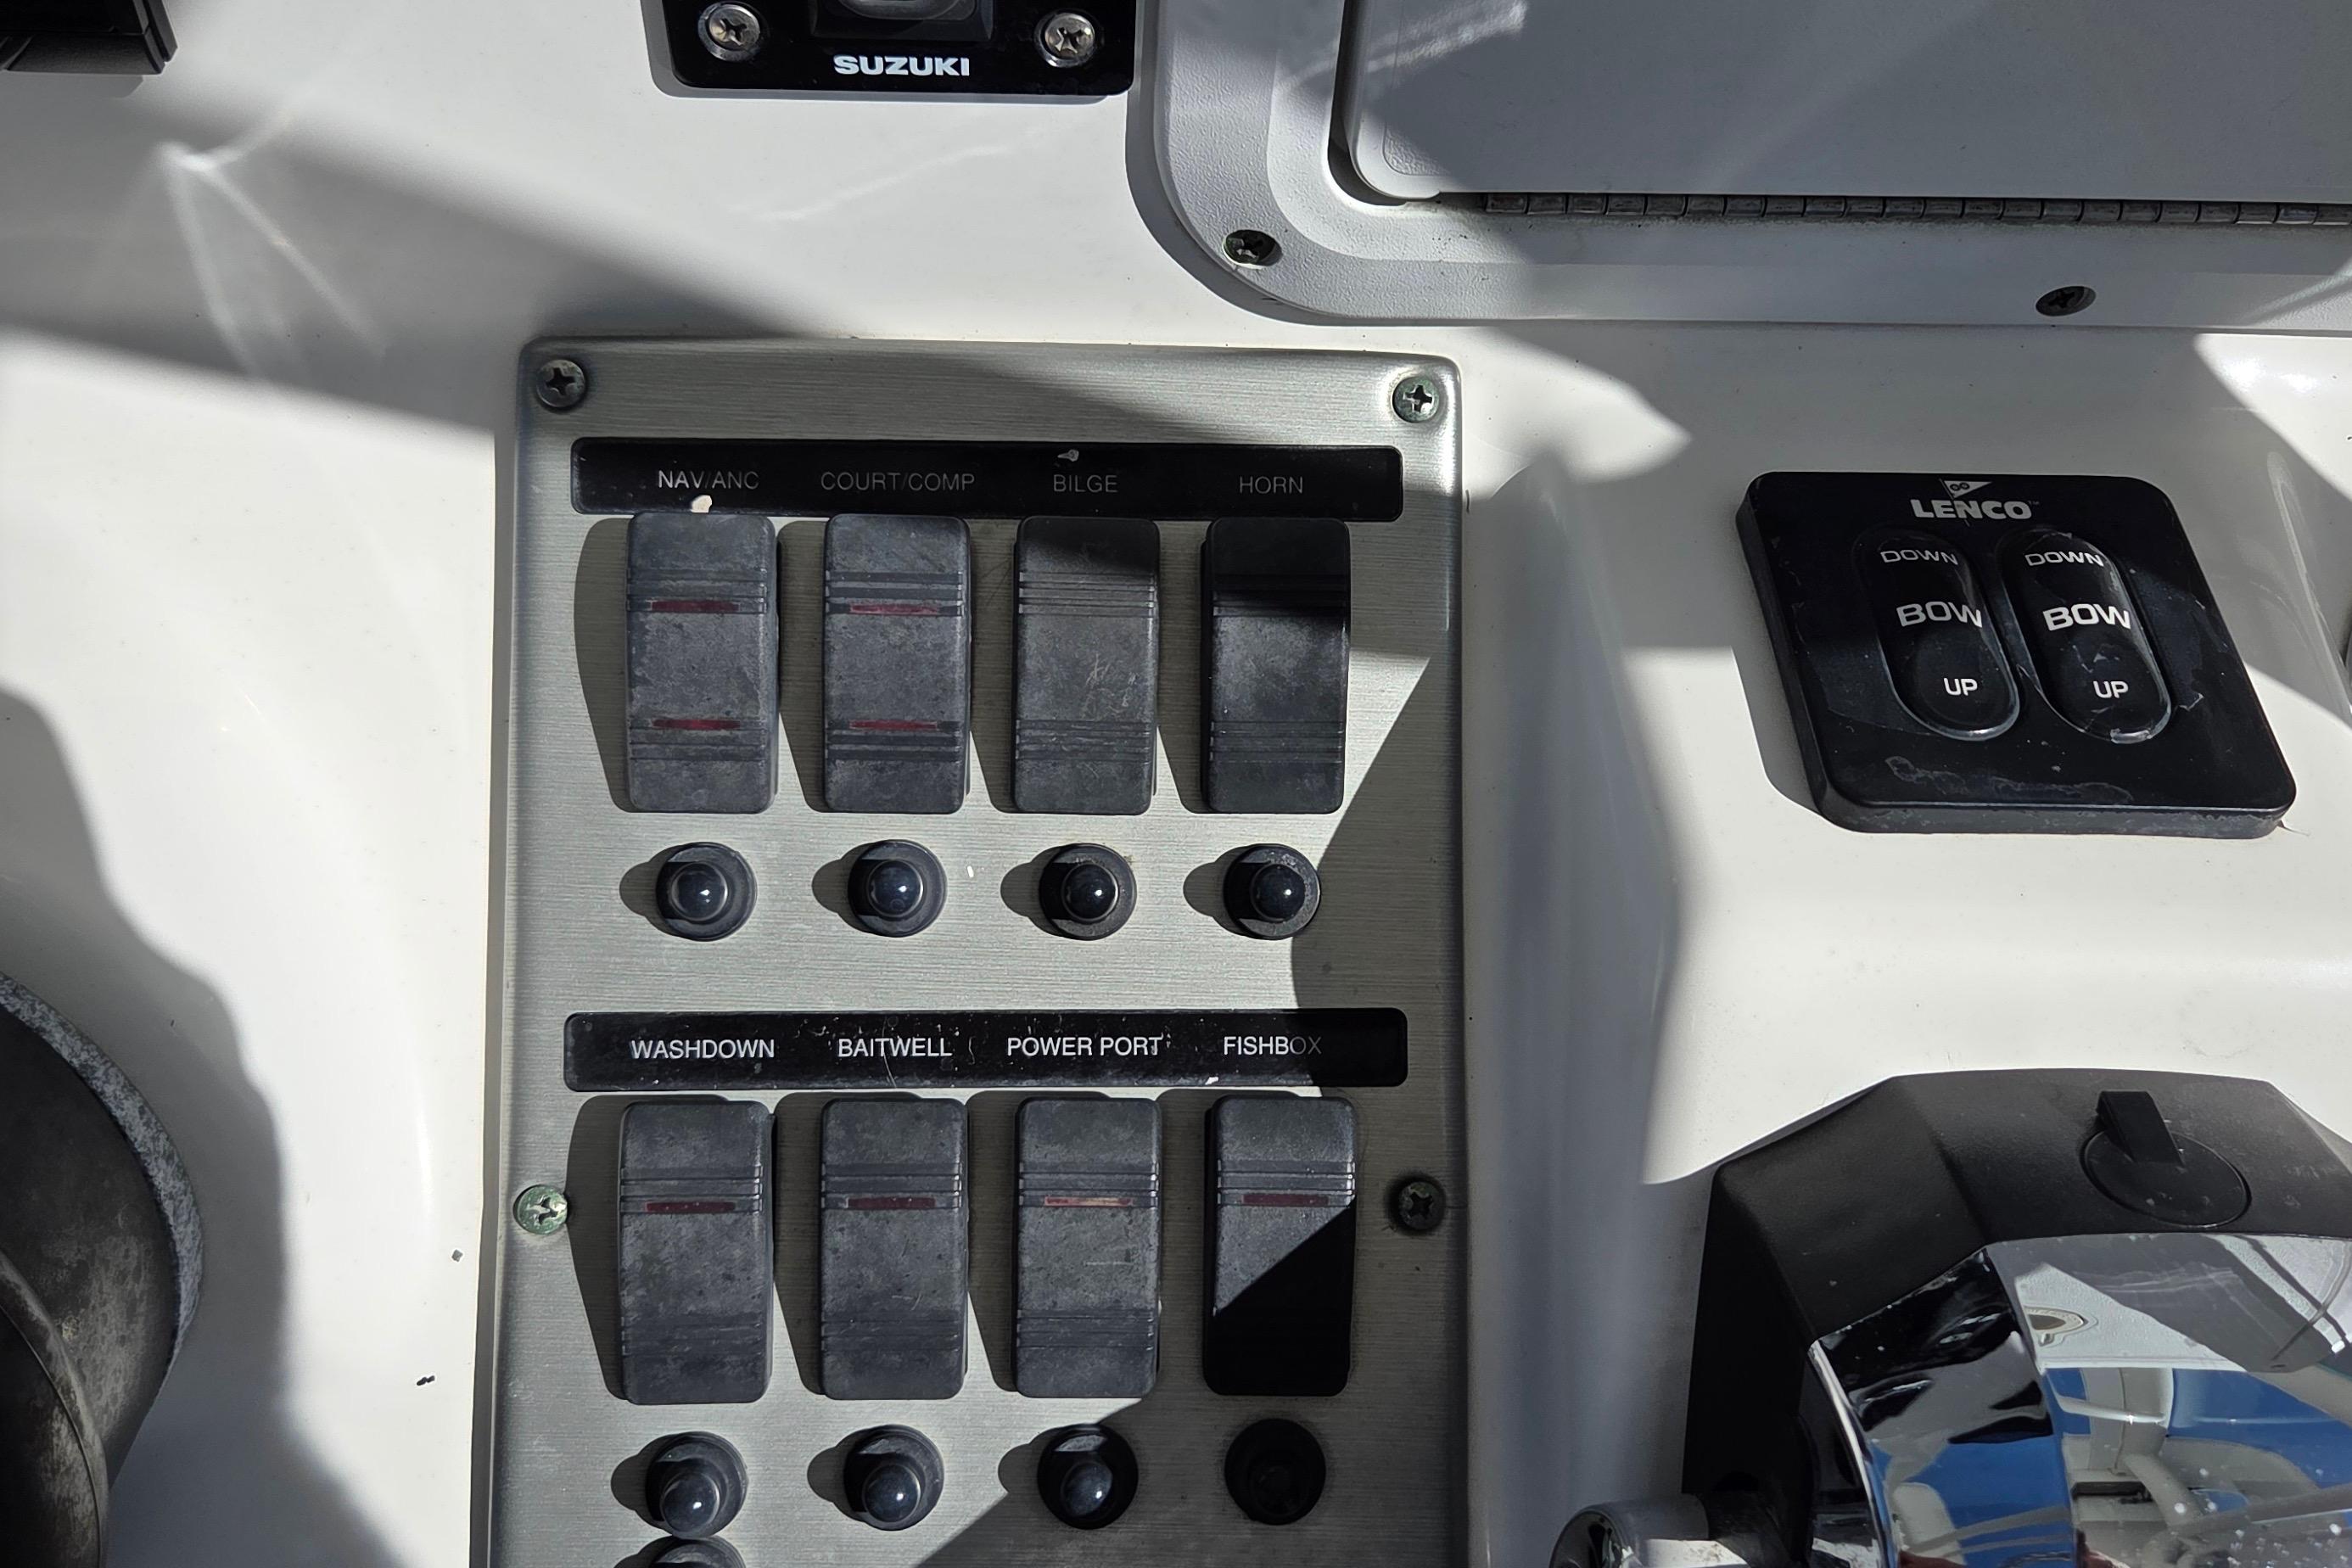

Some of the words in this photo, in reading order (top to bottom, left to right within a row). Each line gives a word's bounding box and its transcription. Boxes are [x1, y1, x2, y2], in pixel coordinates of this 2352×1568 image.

[833, 54, 971, 77] SUZUKI
[1052, 473, 1118, 494] BILGE
[1239, 475, 1304, 496] HORN
[1910, 498, 2033, 521] LENCO
[1879, 548, 1960, 567] DOWN
[2024, 550, 2105, 568] DOWN
[1895, 600, 1983, 629] BOW
[2041, 602, 2131, 631] BOW
[1942, 676, 1979, 697] UP
[2092, 679, 2130, 699] UP
[630, 1038, 776, 1061] WASHDOWN
[837, 1037, 953, 1058] BAITWELL
[1006, 1036, 1093, 1057] POWER
[1099, 1036, 1162, 1057] PORT
[1223, 1035, 1323, 1056] FISHBOX
